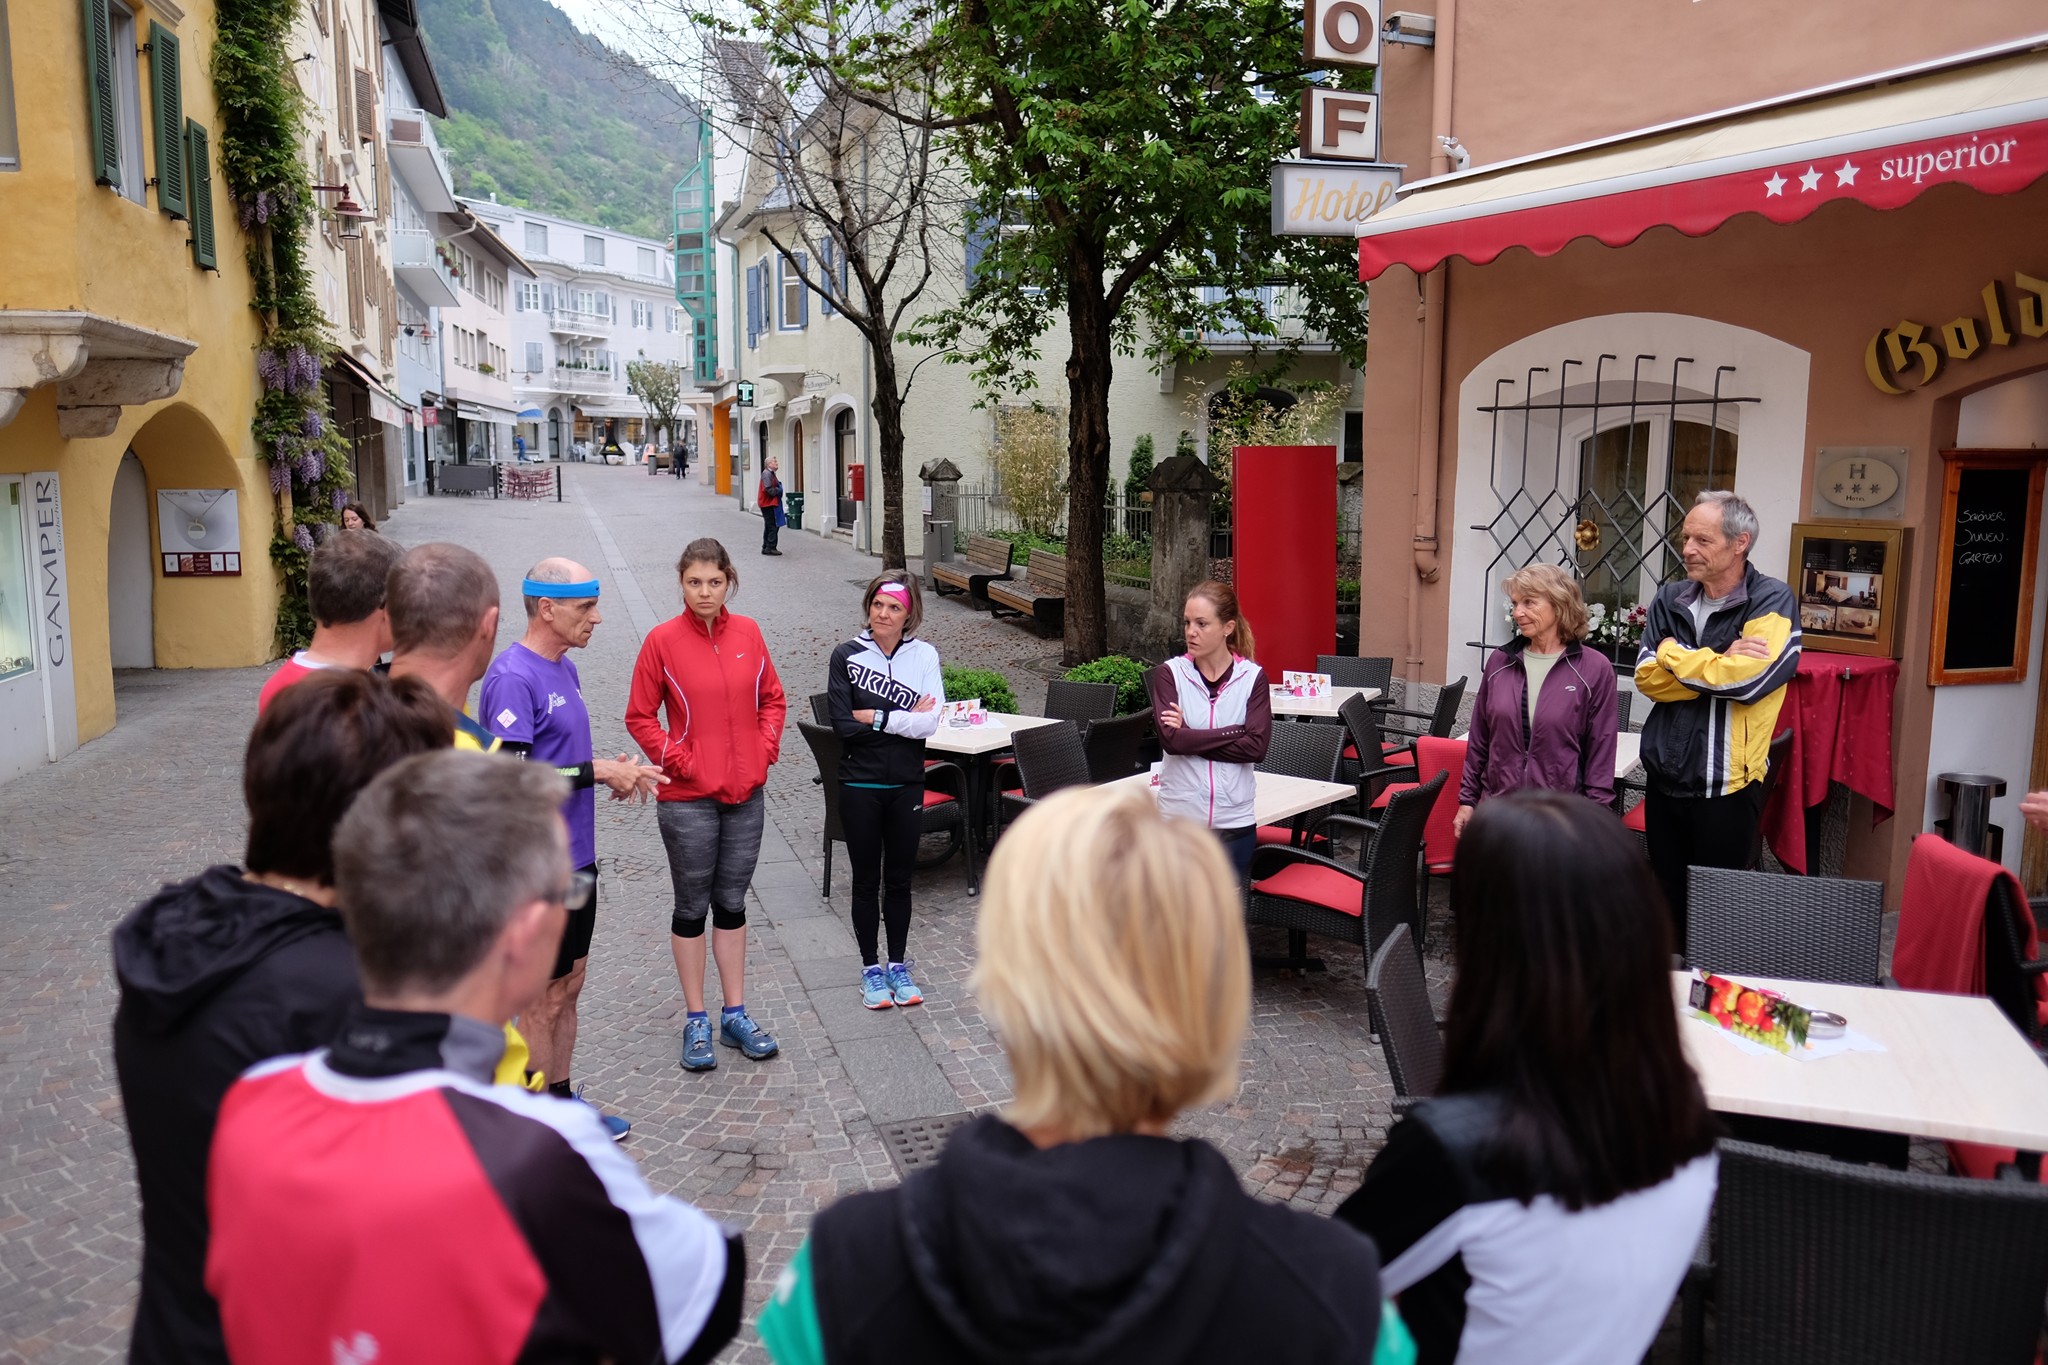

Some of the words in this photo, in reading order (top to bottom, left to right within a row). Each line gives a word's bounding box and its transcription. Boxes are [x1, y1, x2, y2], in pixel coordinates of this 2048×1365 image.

[1880, 135, 2018, 185] superior
[1288, 177, 1394, 223] Hotel
[1849, 463, 1867, 480] H
[51, 478, 63, 552] Goldschmied
[35, 478, 66, 668] GAMPER
[1958, 551, 2003, 565] GARTEN
